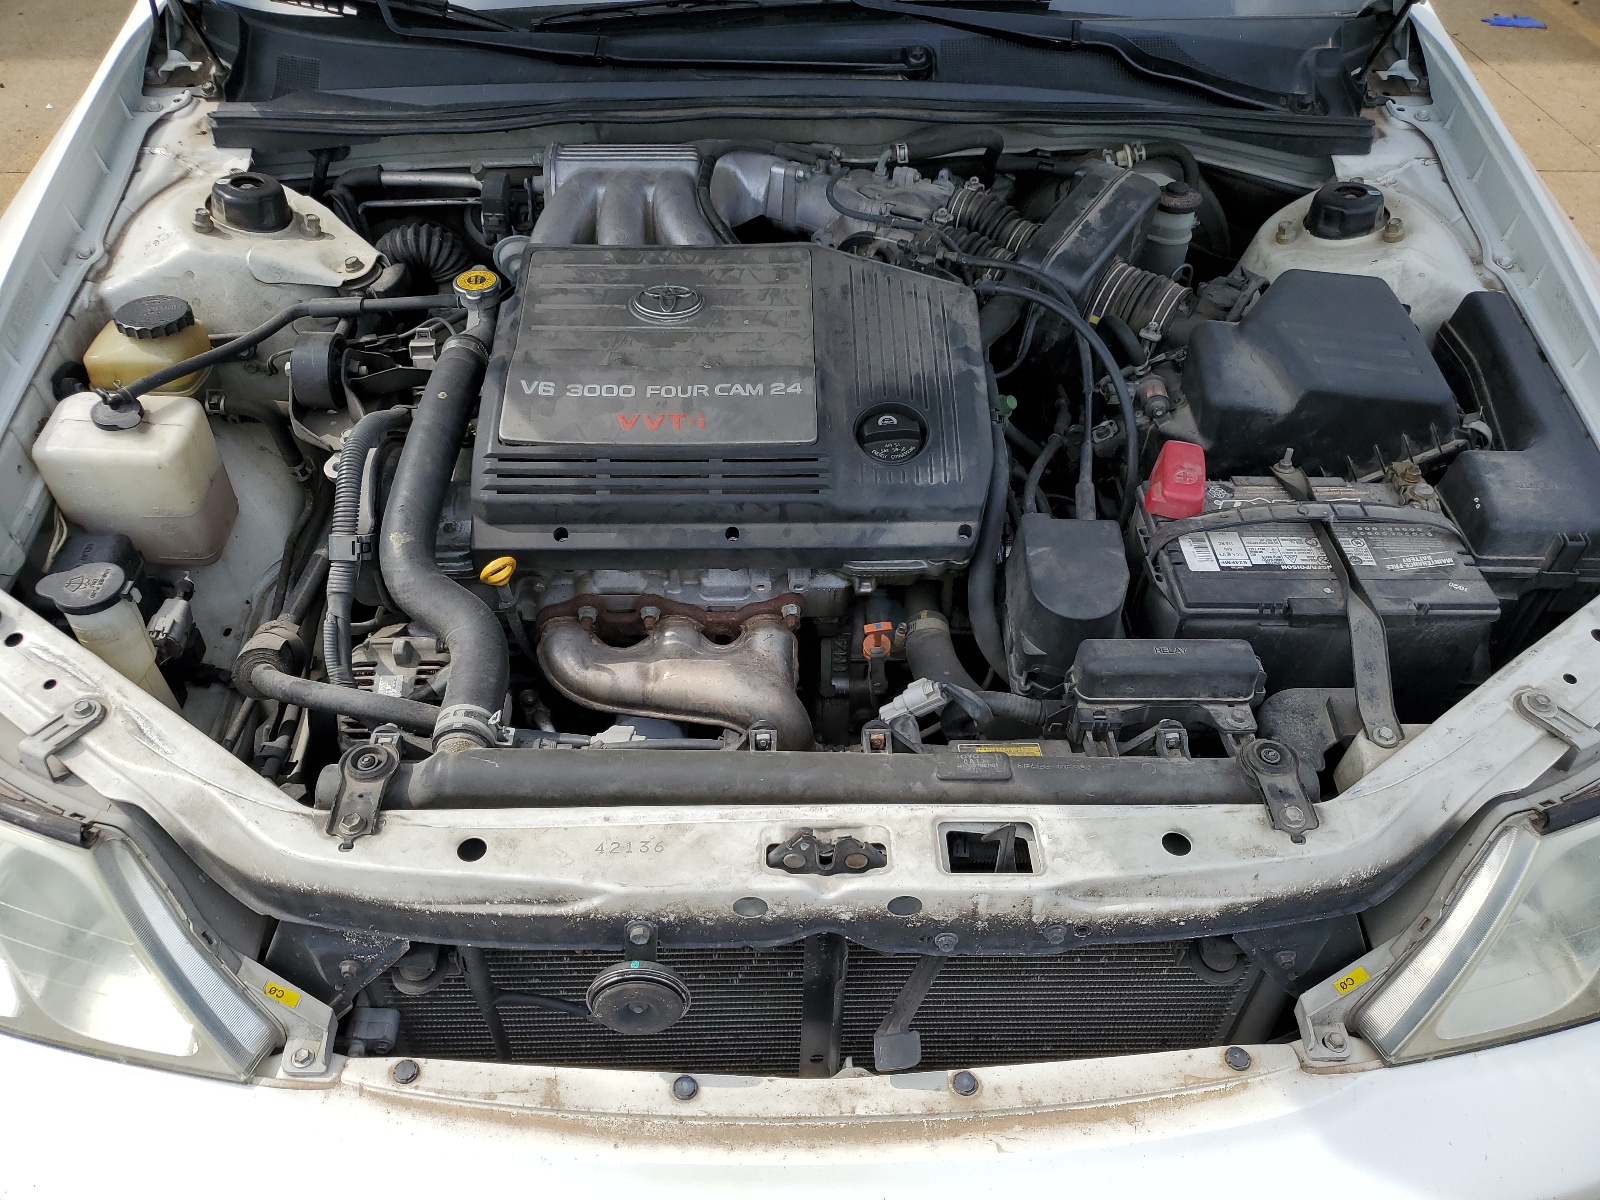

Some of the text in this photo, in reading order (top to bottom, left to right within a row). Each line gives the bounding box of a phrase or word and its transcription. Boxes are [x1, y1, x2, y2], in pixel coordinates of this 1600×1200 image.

[520, 379, 803, 398] V6 3000 FOUR CAM 24
[1384, 557, 1455, 571] MAINTENANCE-FREE
[1402, 555, 1433, 564] BATTERY
[1154, 646, 1188, 655] RELAY
[594, 840, 665, 854] 42136
